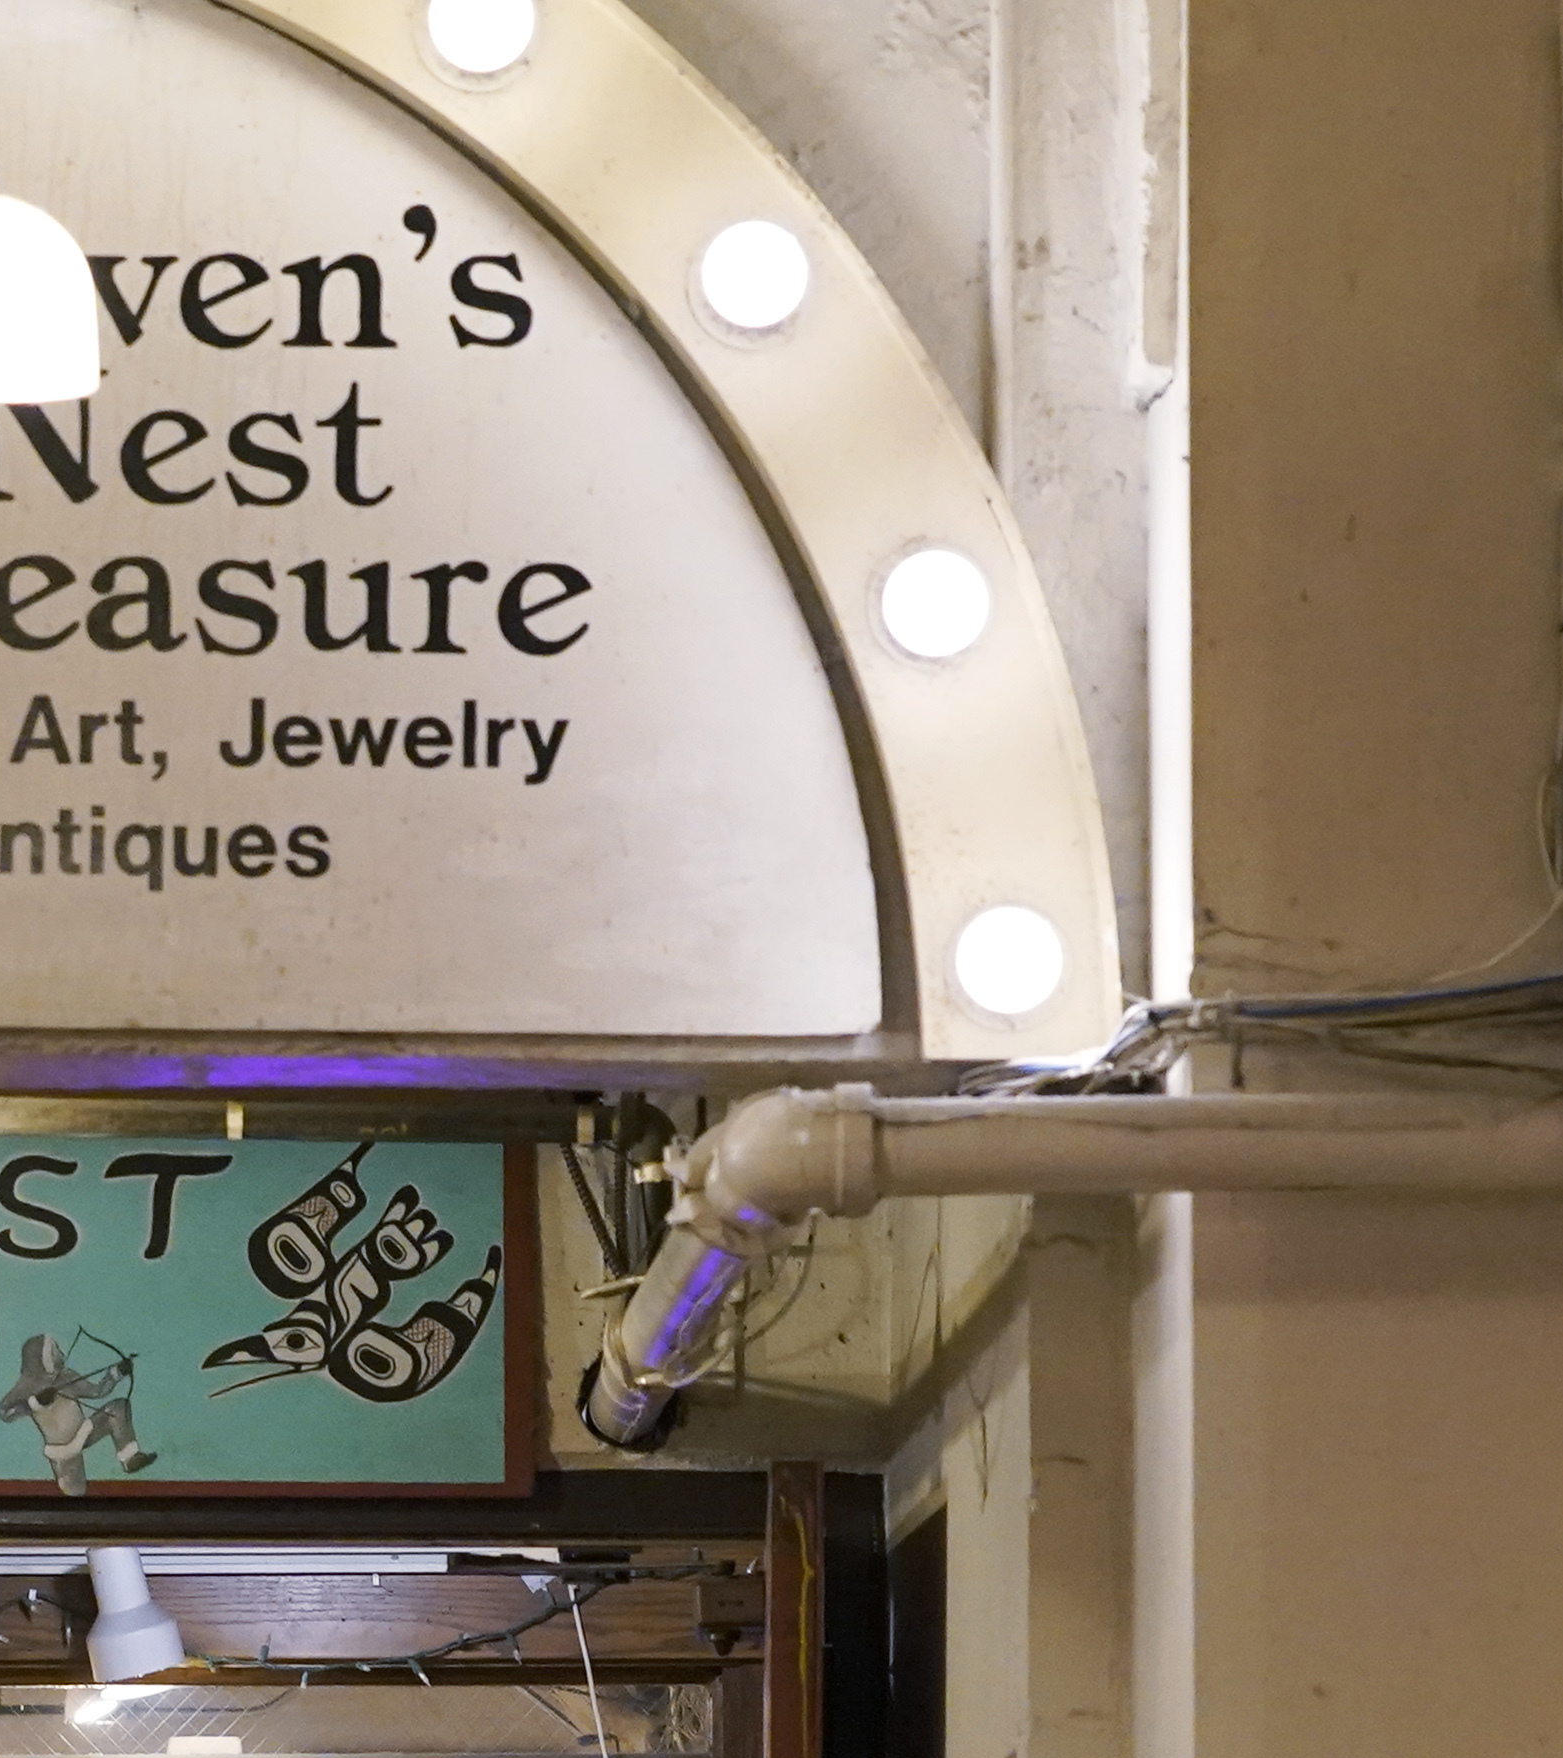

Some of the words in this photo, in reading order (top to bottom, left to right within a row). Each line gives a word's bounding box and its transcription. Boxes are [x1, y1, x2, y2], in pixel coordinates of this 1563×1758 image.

[94, 204, 535, 352] ven's
[10, 695, 170, 778] Art,
[218, 699, 569, 785] Jewelry
